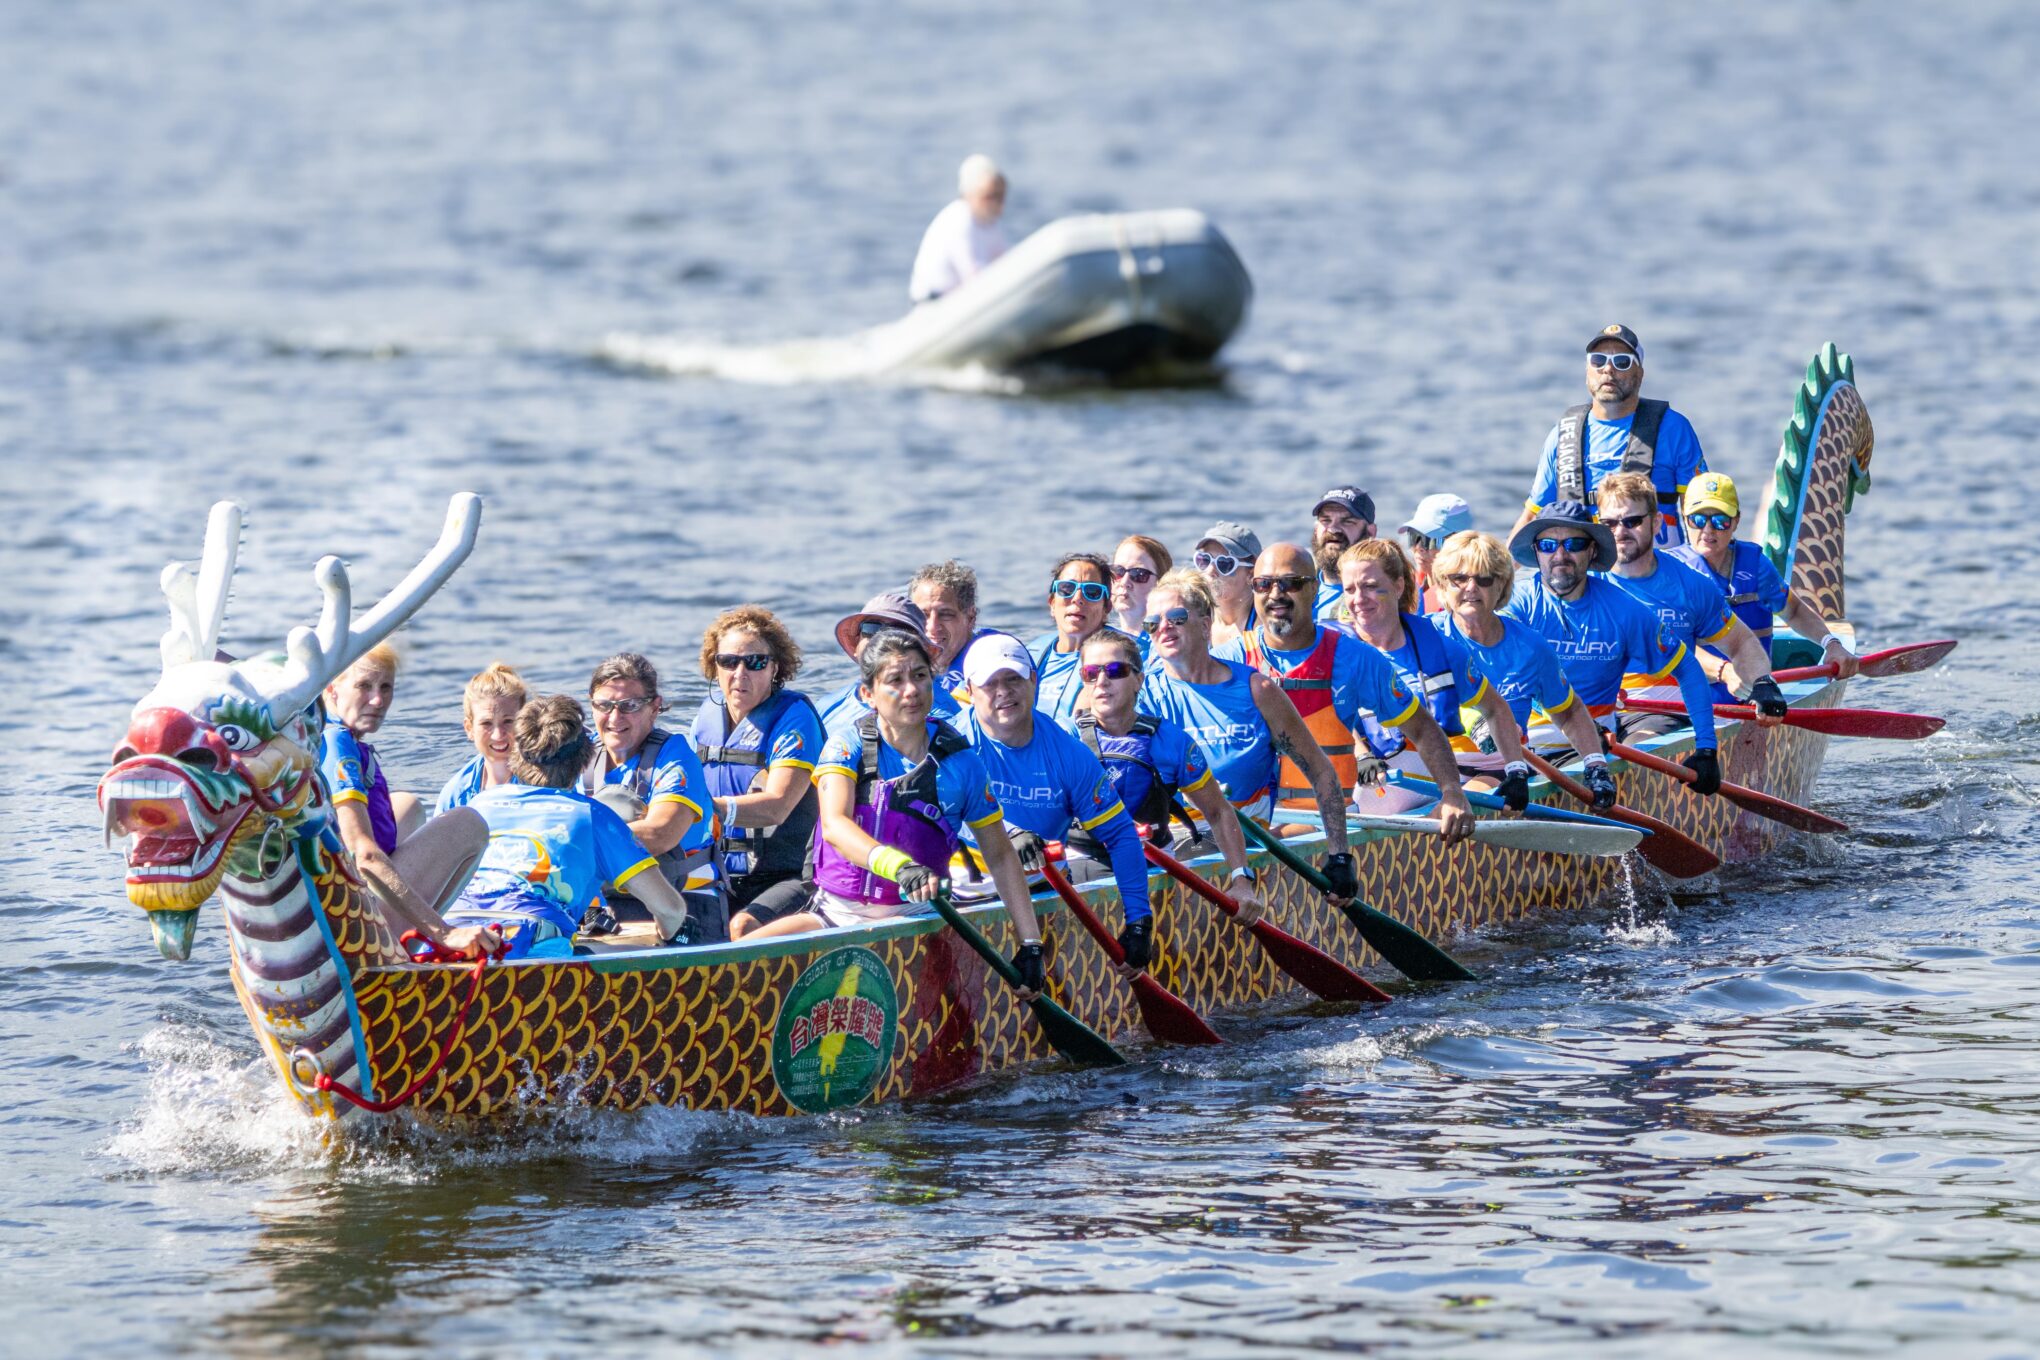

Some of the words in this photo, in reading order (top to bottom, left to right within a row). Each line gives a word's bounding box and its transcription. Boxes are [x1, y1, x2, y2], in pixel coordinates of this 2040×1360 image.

[1560, 415, 1577, 442] LIFE
[1559, 443, 1576, 488] JACKET
[789, 995, 885, 1059] 台灣榮耀號
